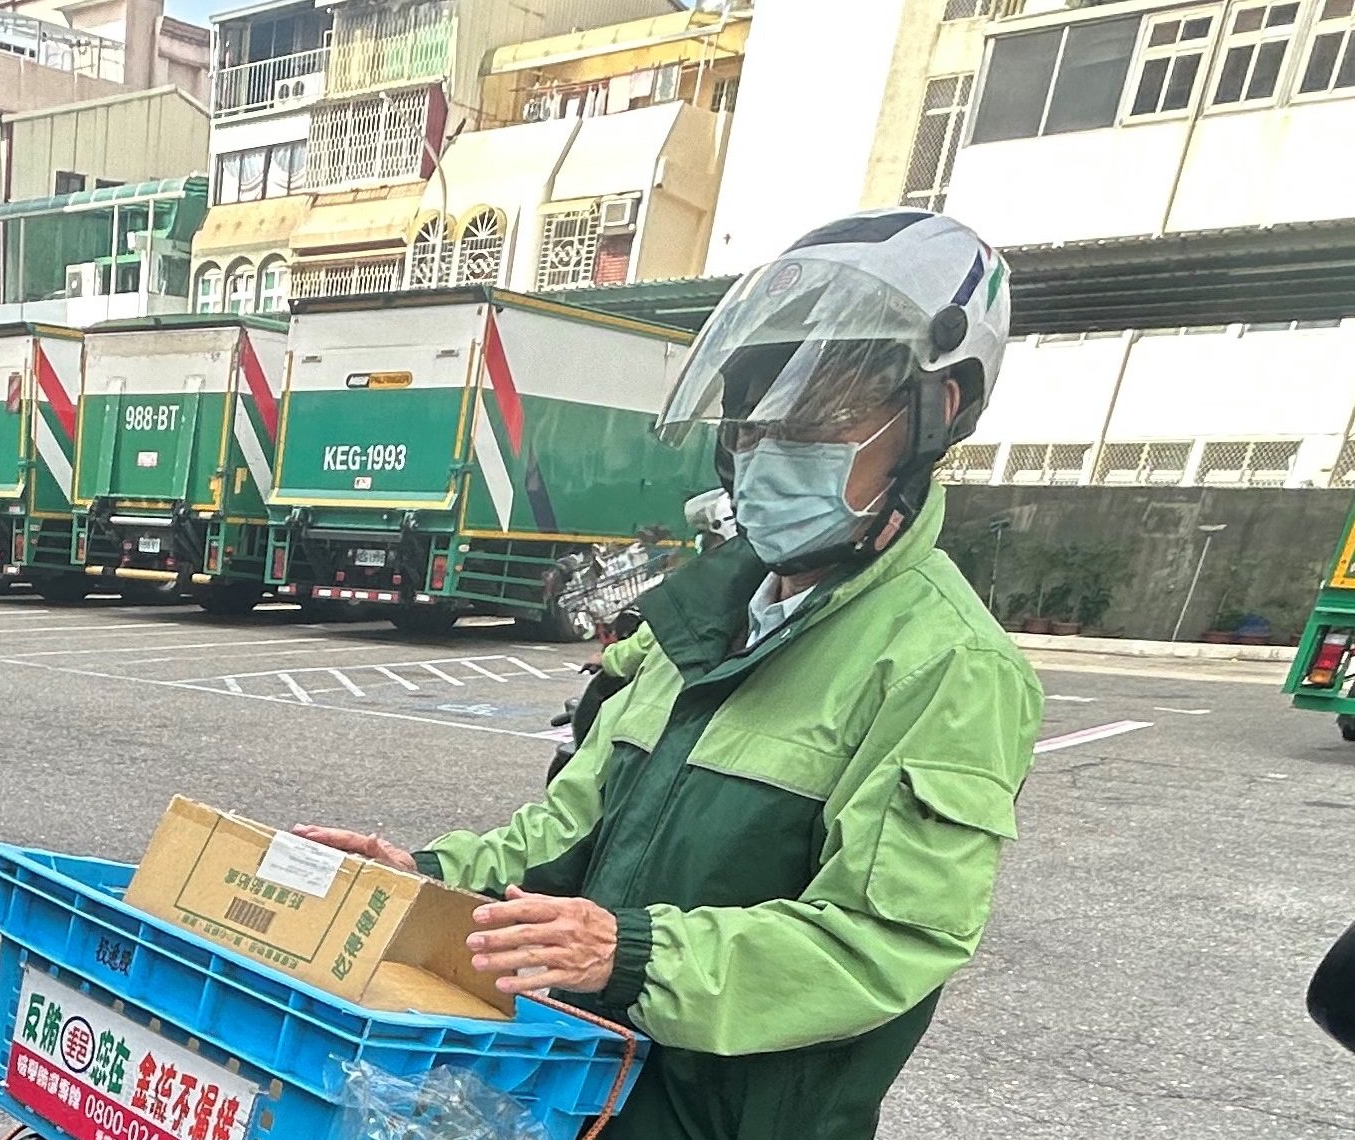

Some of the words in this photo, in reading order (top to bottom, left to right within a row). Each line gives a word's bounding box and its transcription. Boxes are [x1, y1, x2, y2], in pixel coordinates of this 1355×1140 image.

[125, 405, 180, 431] 988-BT
[323, 444, 407, 471] KEG-1993
[331, 885, 391, 981] 吃得健康
